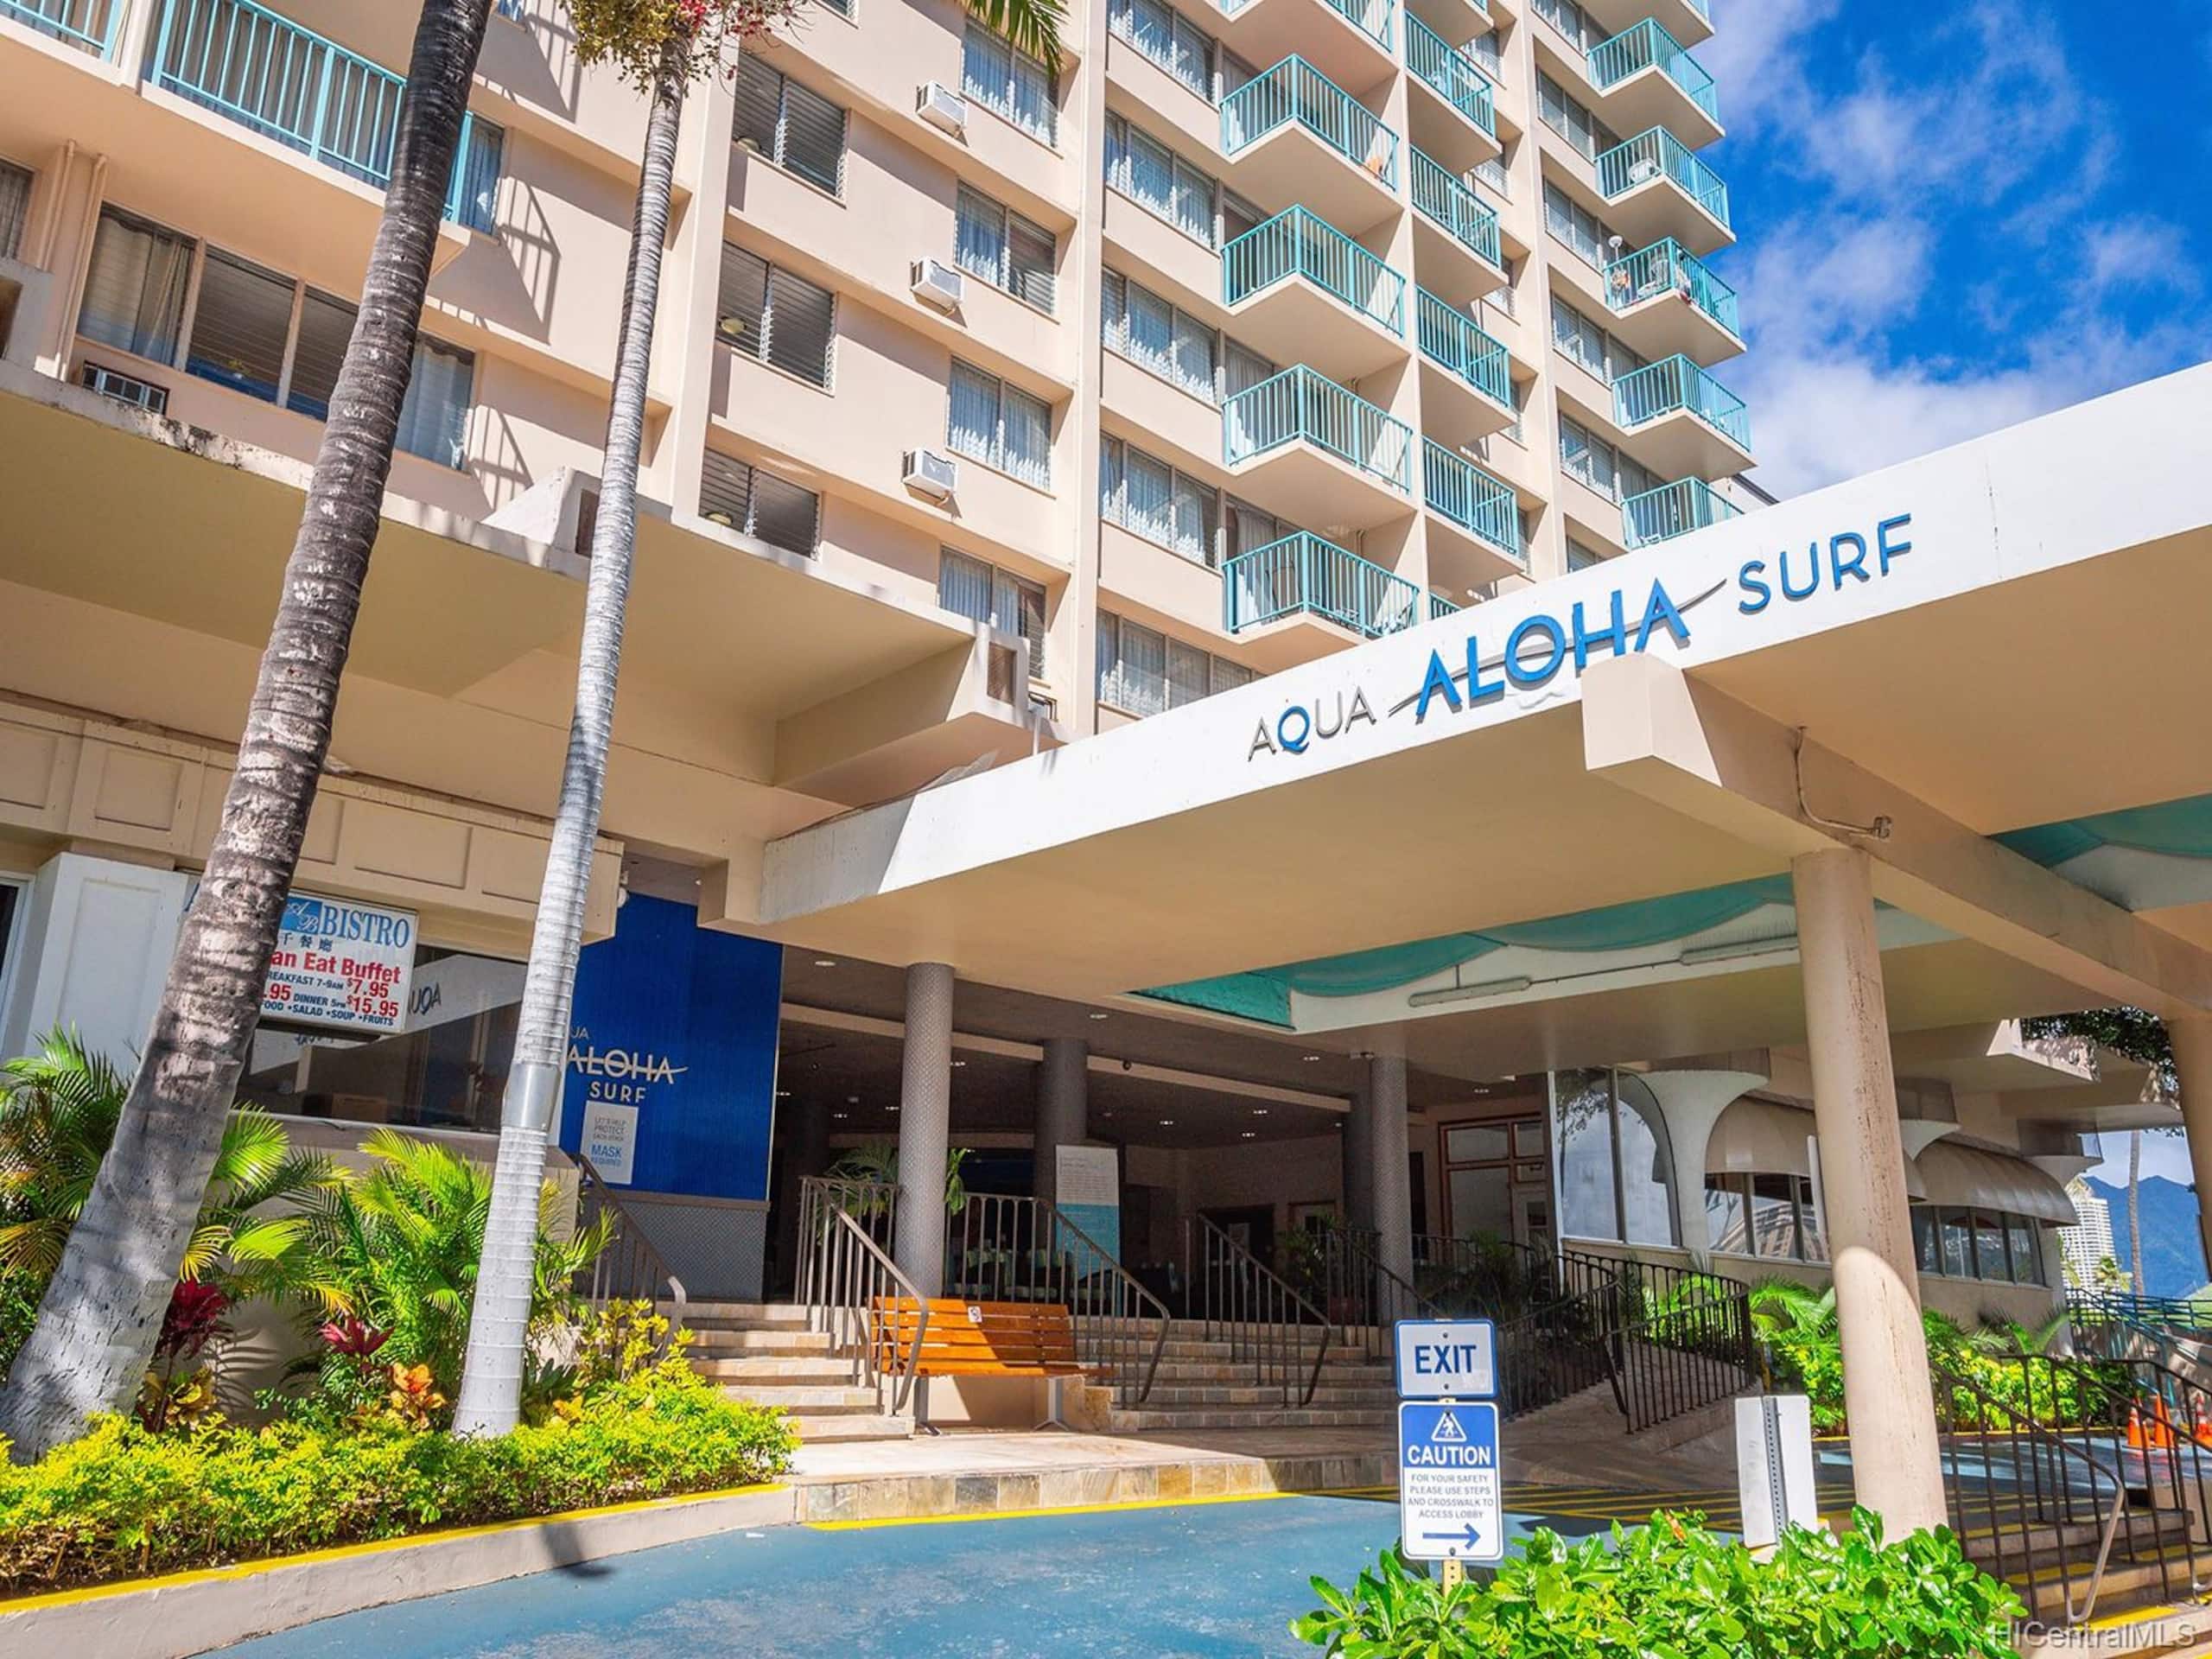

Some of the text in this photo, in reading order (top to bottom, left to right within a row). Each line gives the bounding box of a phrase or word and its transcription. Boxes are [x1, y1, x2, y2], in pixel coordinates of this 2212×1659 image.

[1248, 513, 1912, 761] AQUA ALOHA SURF
[321, 906, 410, 948] BISTRO
[270, 951, 401, 983] an Eat Buffet
[347, 977, 389, 999] $7.95
[294, 994, 329, 1006] DINNER
[346, 995, 399, 1017] $15.95
[567, 1044, 674, 1084] ALOHA
[589, 1081, 646, 1103] SURF
[591, 1144, 623, 1158] MASK
[1414, 1344, 1477, 1374] EXIT
[1407, 1445, 1491, 1465] CAUTION
[1411, 1474, 1488, 1484] FOR YOUR SAFETY
[1409, 1486, 1491, 1495] PLEASE USE STEPS
[1408, 1497, 1494, 1507] AND CROSSWALK TO
[1418, 1510, 1484, 1519] ACCESS LOBBY
